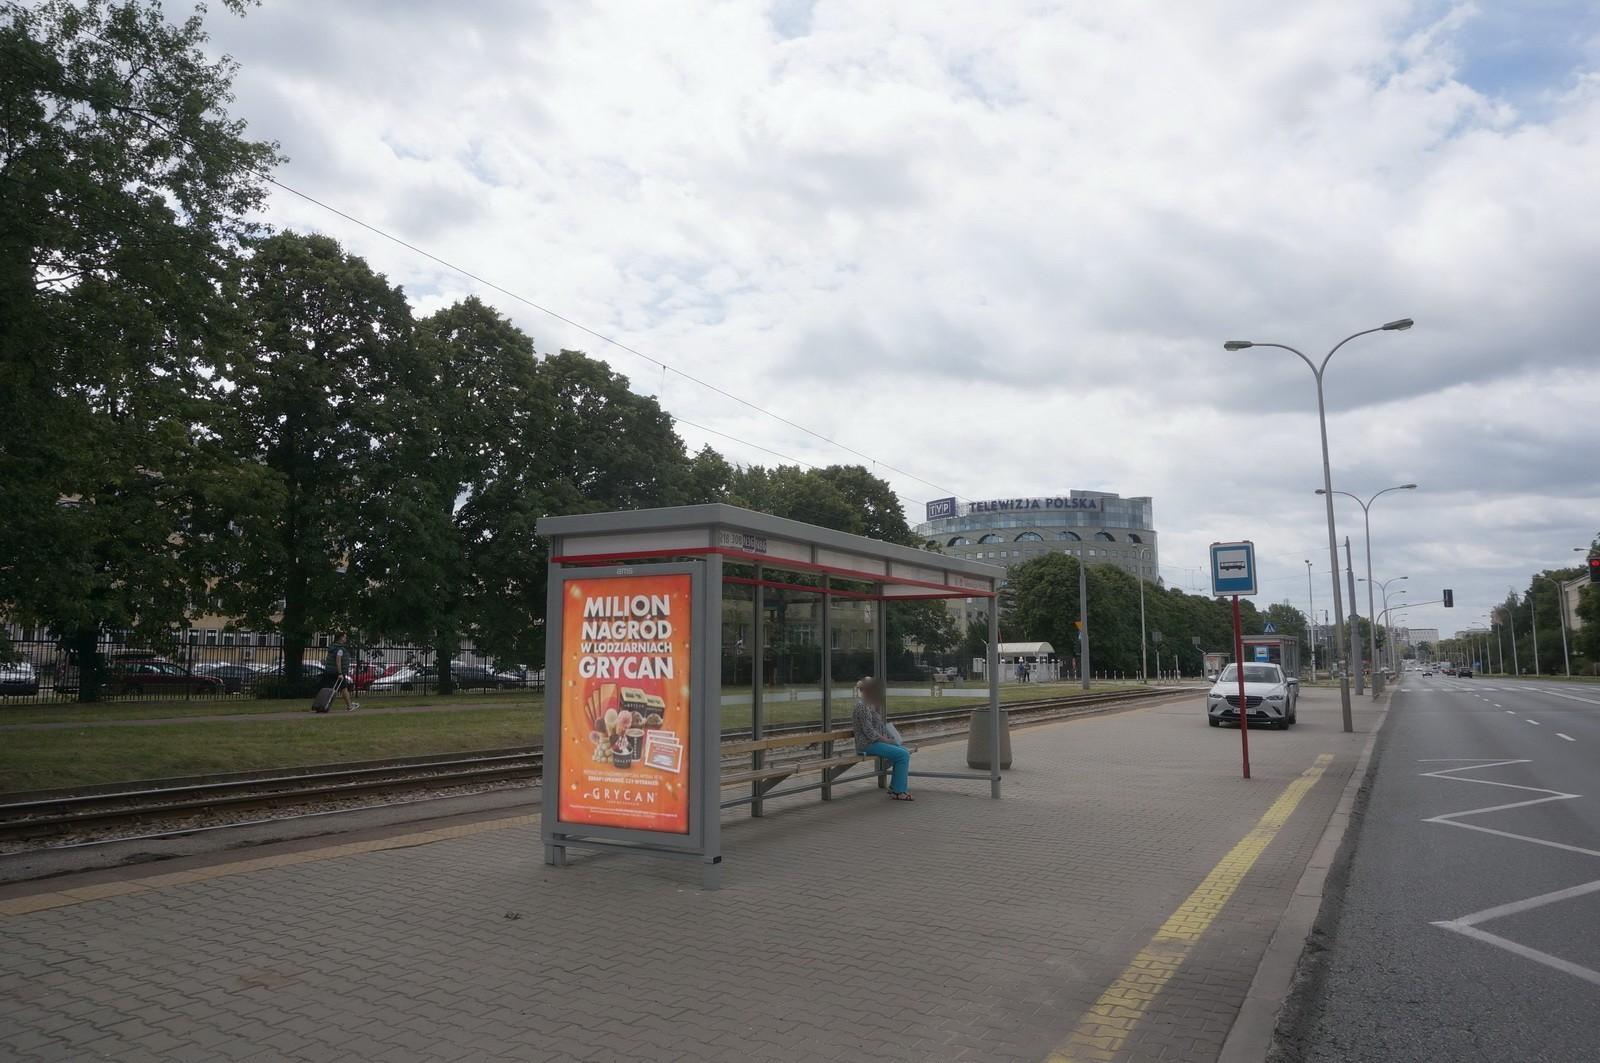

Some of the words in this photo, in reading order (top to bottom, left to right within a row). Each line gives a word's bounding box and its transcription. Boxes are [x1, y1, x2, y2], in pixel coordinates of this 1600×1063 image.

[969, 498, 1041, 513] TELEWIZJA
[1046, 497, 1097, 510] POLSKA
[583, 594, 670, 617] MILION
[581, 614, 672, 640] NAGRÓD
[581, 642, 592, 653] W
[594, 641, 672, 653] LODZIARNIACH
[579, 656, 674, 679] GRYCAN
[591, 787, 655, 803] GRYCAN
